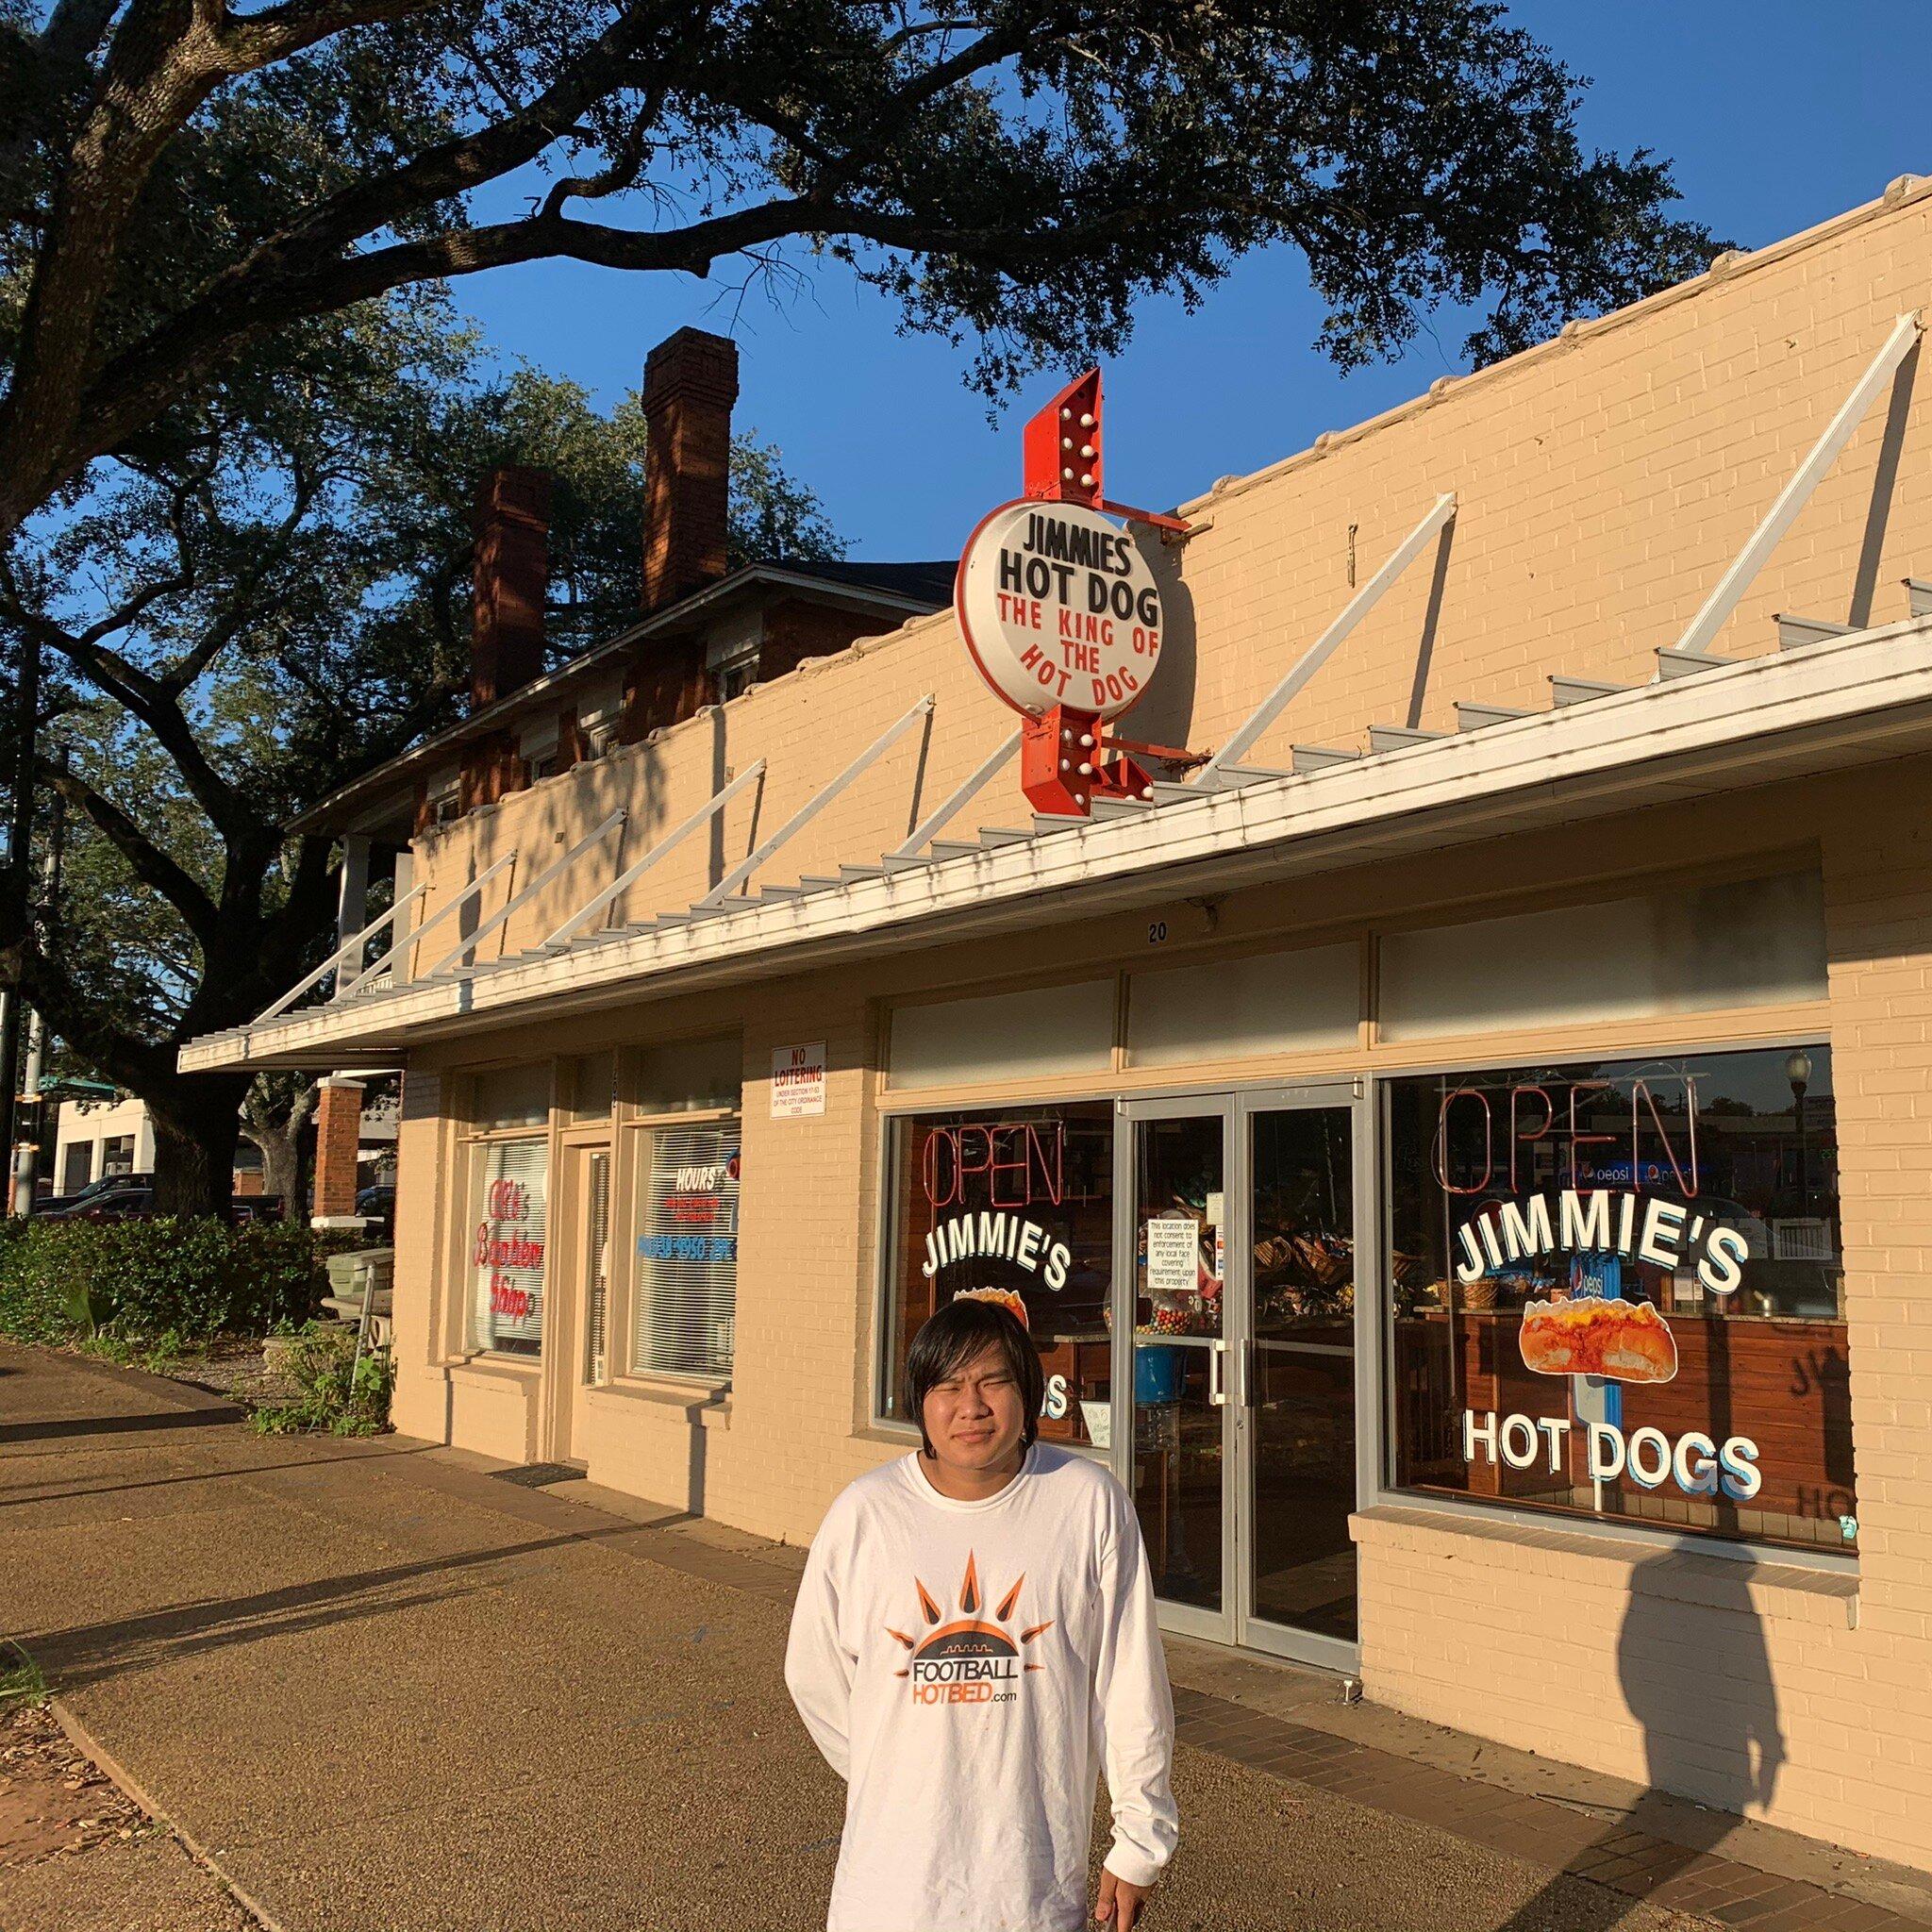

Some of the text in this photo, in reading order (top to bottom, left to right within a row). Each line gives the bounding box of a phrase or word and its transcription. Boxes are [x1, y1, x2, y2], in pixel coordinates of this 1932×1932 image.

[1024, 512, 1131, 576] JIMMIES
[1000, 548, 1158, 627] HOT DOG
[997, 592, 1158, 657] THE KING OF
[1060, 640, 1099, 674] THE
[1020, 643, 1139, 706] HOT DOG
[1148, 922, 1167, 943] 20
[791, 1047, 806, 1066] NO
[774, 1065, 822, 1087] LOITERING
[788, 1097, 797, 1106] CITY
[791, 1088, 808, 1096] SECTION
[1439, 1076, 1698, 1198] OPEN
[675, 1166, 715, 1191] HOURS
[924, 1123, 1064, 1208] OPEN
[1597, 1167, 1628, 1184] pepsi
[922, 1211, 1071, 1291] JIMMIE'S
[1457, 1190, 1749, 1296] JIMMIE'S
[1583, 1274, 1604, 1295] pepsi
[1462, 1408, 1762, 1500] HOT DOGS
[913, 1659, 1019, 1682] FOOTBALL
[913, 1682, 1017, 1706] HOTBED.com
